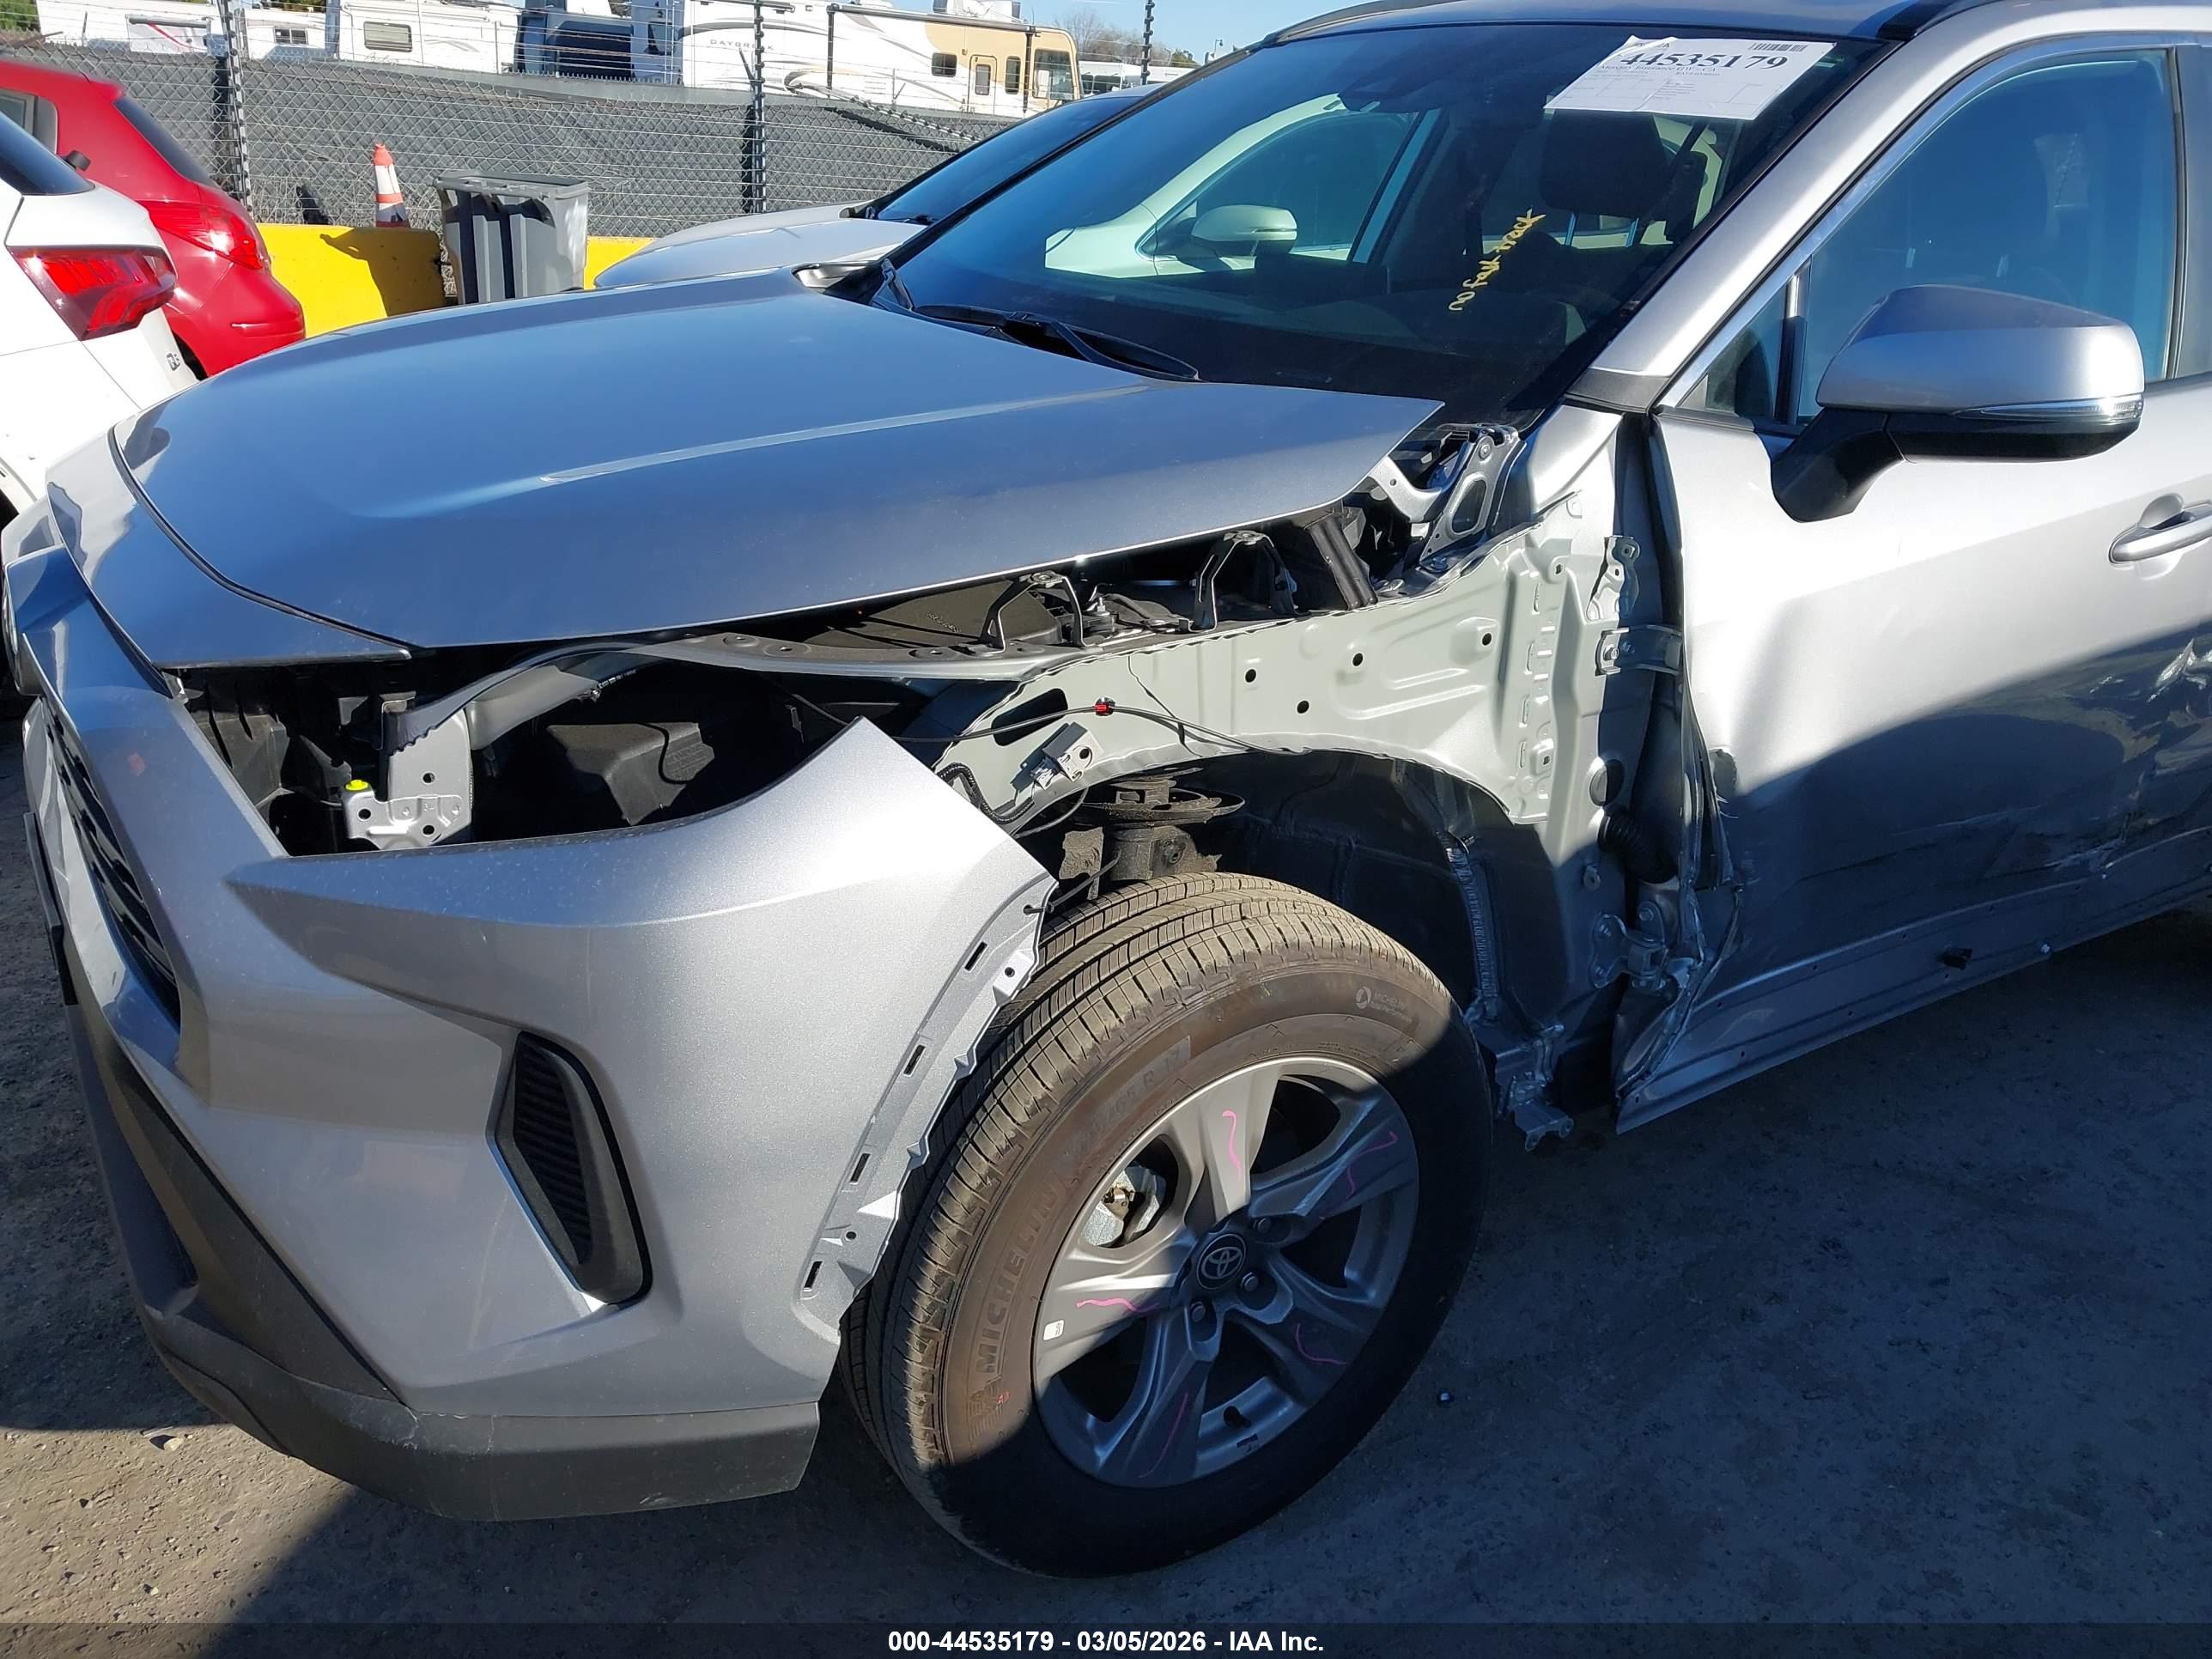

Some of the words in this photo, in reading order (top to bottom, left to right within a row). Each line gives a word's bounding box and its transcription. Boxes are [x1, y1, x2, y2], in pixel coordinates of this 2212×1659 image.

[710, 39, 775, 51] DAYBREK
[1620, 52, 1789, 70] 44535179
[975, 1182, 1063, 1374] MICHELIN
